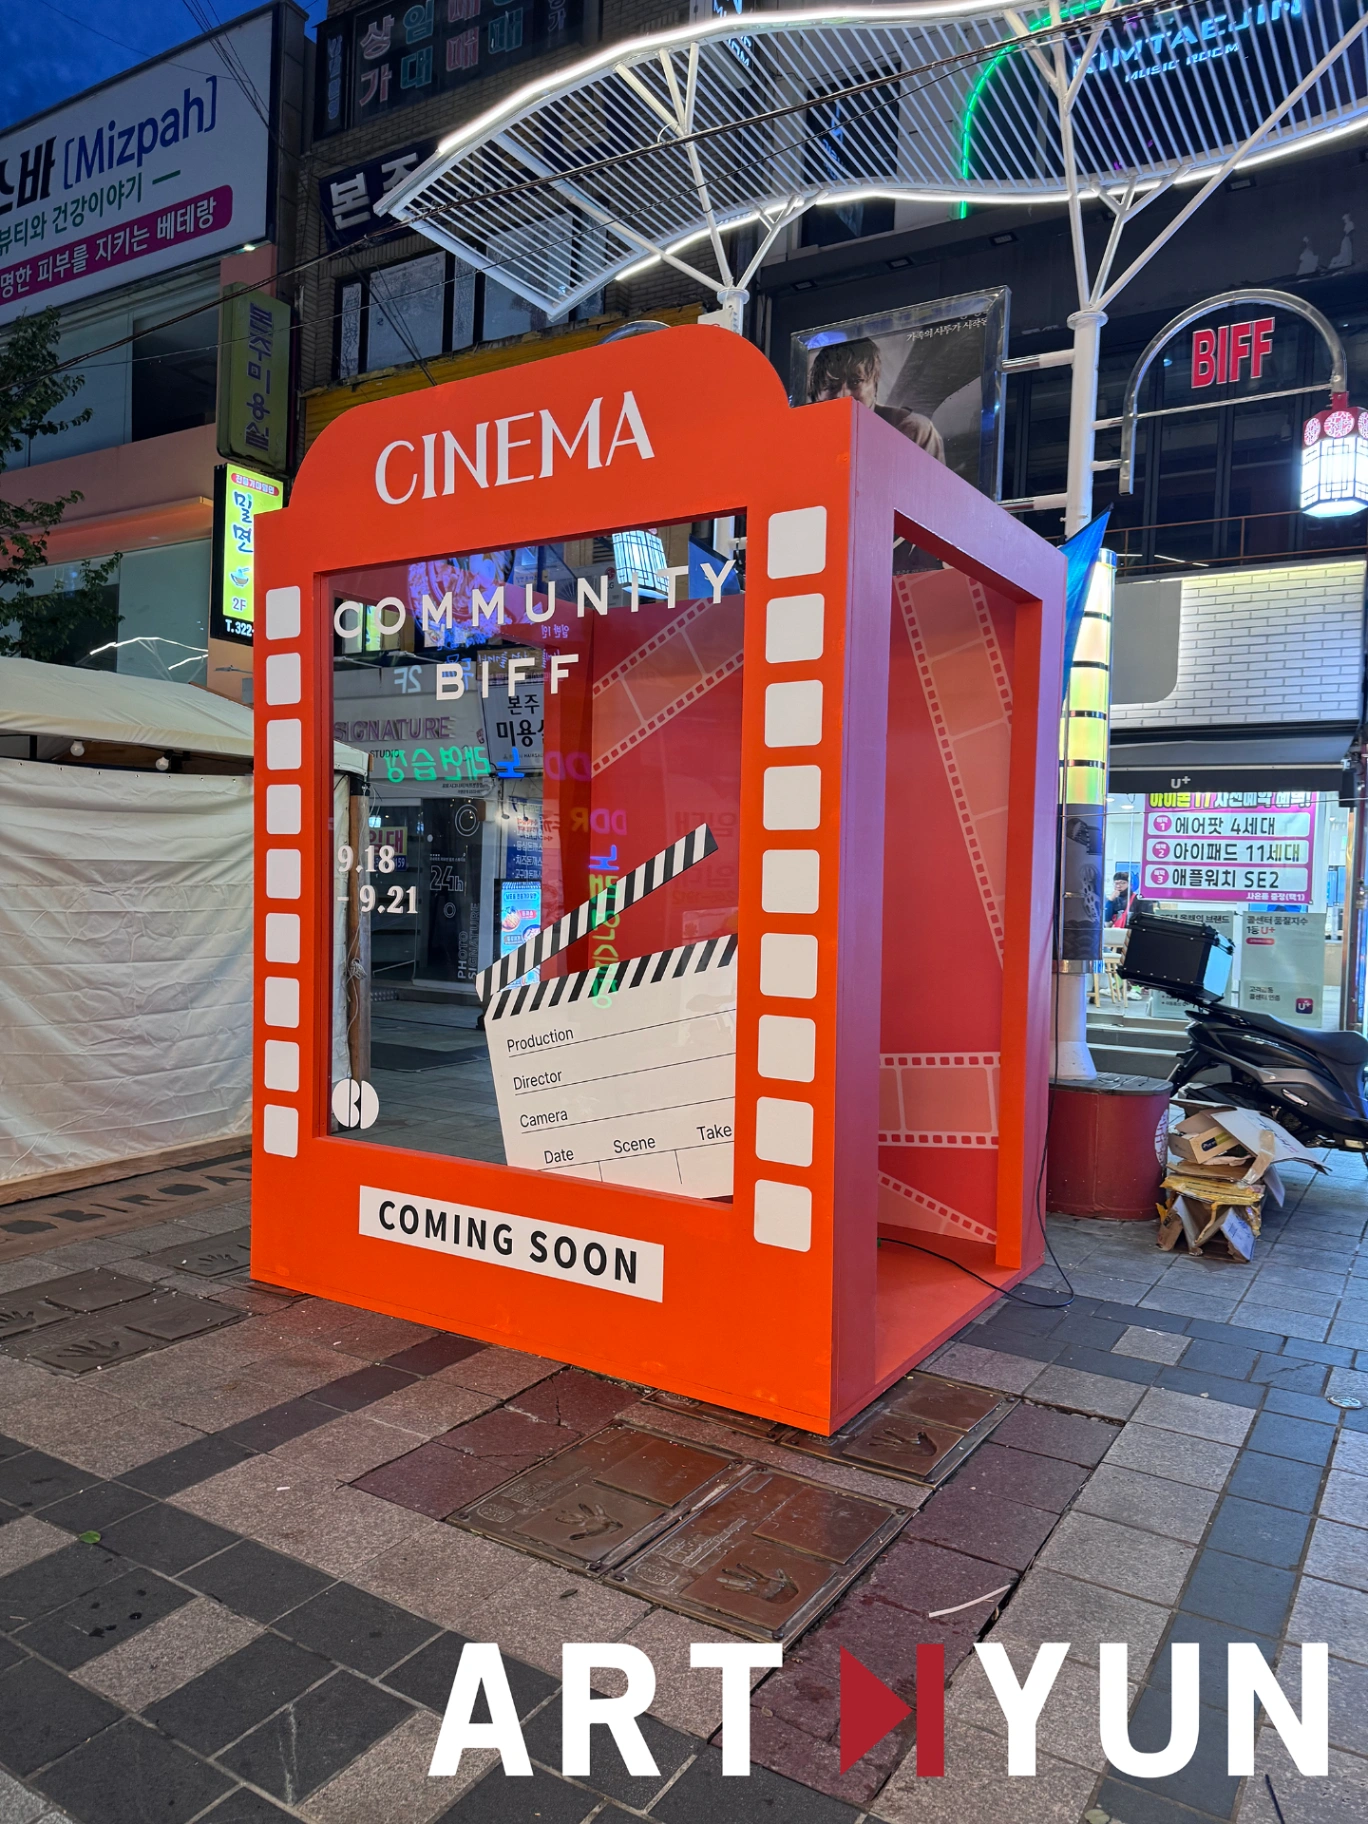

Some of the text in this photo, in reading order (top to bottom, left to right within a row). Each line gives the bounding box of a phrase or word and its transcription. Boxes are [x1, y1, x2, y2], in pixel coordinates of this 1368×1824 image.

[488, 0, 523, 54] 매
[400, 0, 434, 89] 임대
[360, 14, 395, 107] 상가
[1125, 59, 1180, 82] MUSIC
[64, 75, 217, 190] [Mizpah]
[0, 172, 142, 257] 뷰티와 건강이야기
[37, 243, 89, 283] 피부를
[95, 225, 150, 262] 지키는
[156, 197, 217, 240] 베테랑
[1191, 317, 1275, 389] BIFF
[245, 302, 272, 452] 본주미용실
[375, 390, 655, 505] CINEMA
[232, 491, 255, 553] 밀면
[233, 597, 247, 611] 2F
[333, 559, 737, 639] COMMUNITY
[435, 653, 579, 700] BIFF
[507, 694, 541, 715] 본주
[334, 716, 450, 741] SIGNATURE
[496, 719, 543, 748] 미용
[369, 749, 400, 759] STUDIO
[1170, 775, 1191, 789] U+
[1175, 816, 1276, 835] 에어팟 4세대
[337, 845, 395, 873] 9.18
[1173, 843, 1300, 862] 아이패드 11세대
[430, 865, 464, 892] 24h
[1172, 868, 1279, 888] 애플워치 SE2
[360, 884, 418, 914] 9.21
[1205, 914, 1231, 924] 브랜드
[457, 930, 469, 979] PHOTO
[507, 1026, 575, 1054] Production
[513, 1069, 563, 1092] Director
[519, 1107, 569, 1129] Camera
[544, 1122, 733, 1165] Date Scene Take
[378, 1200, 637, 1284] COMING SOON
